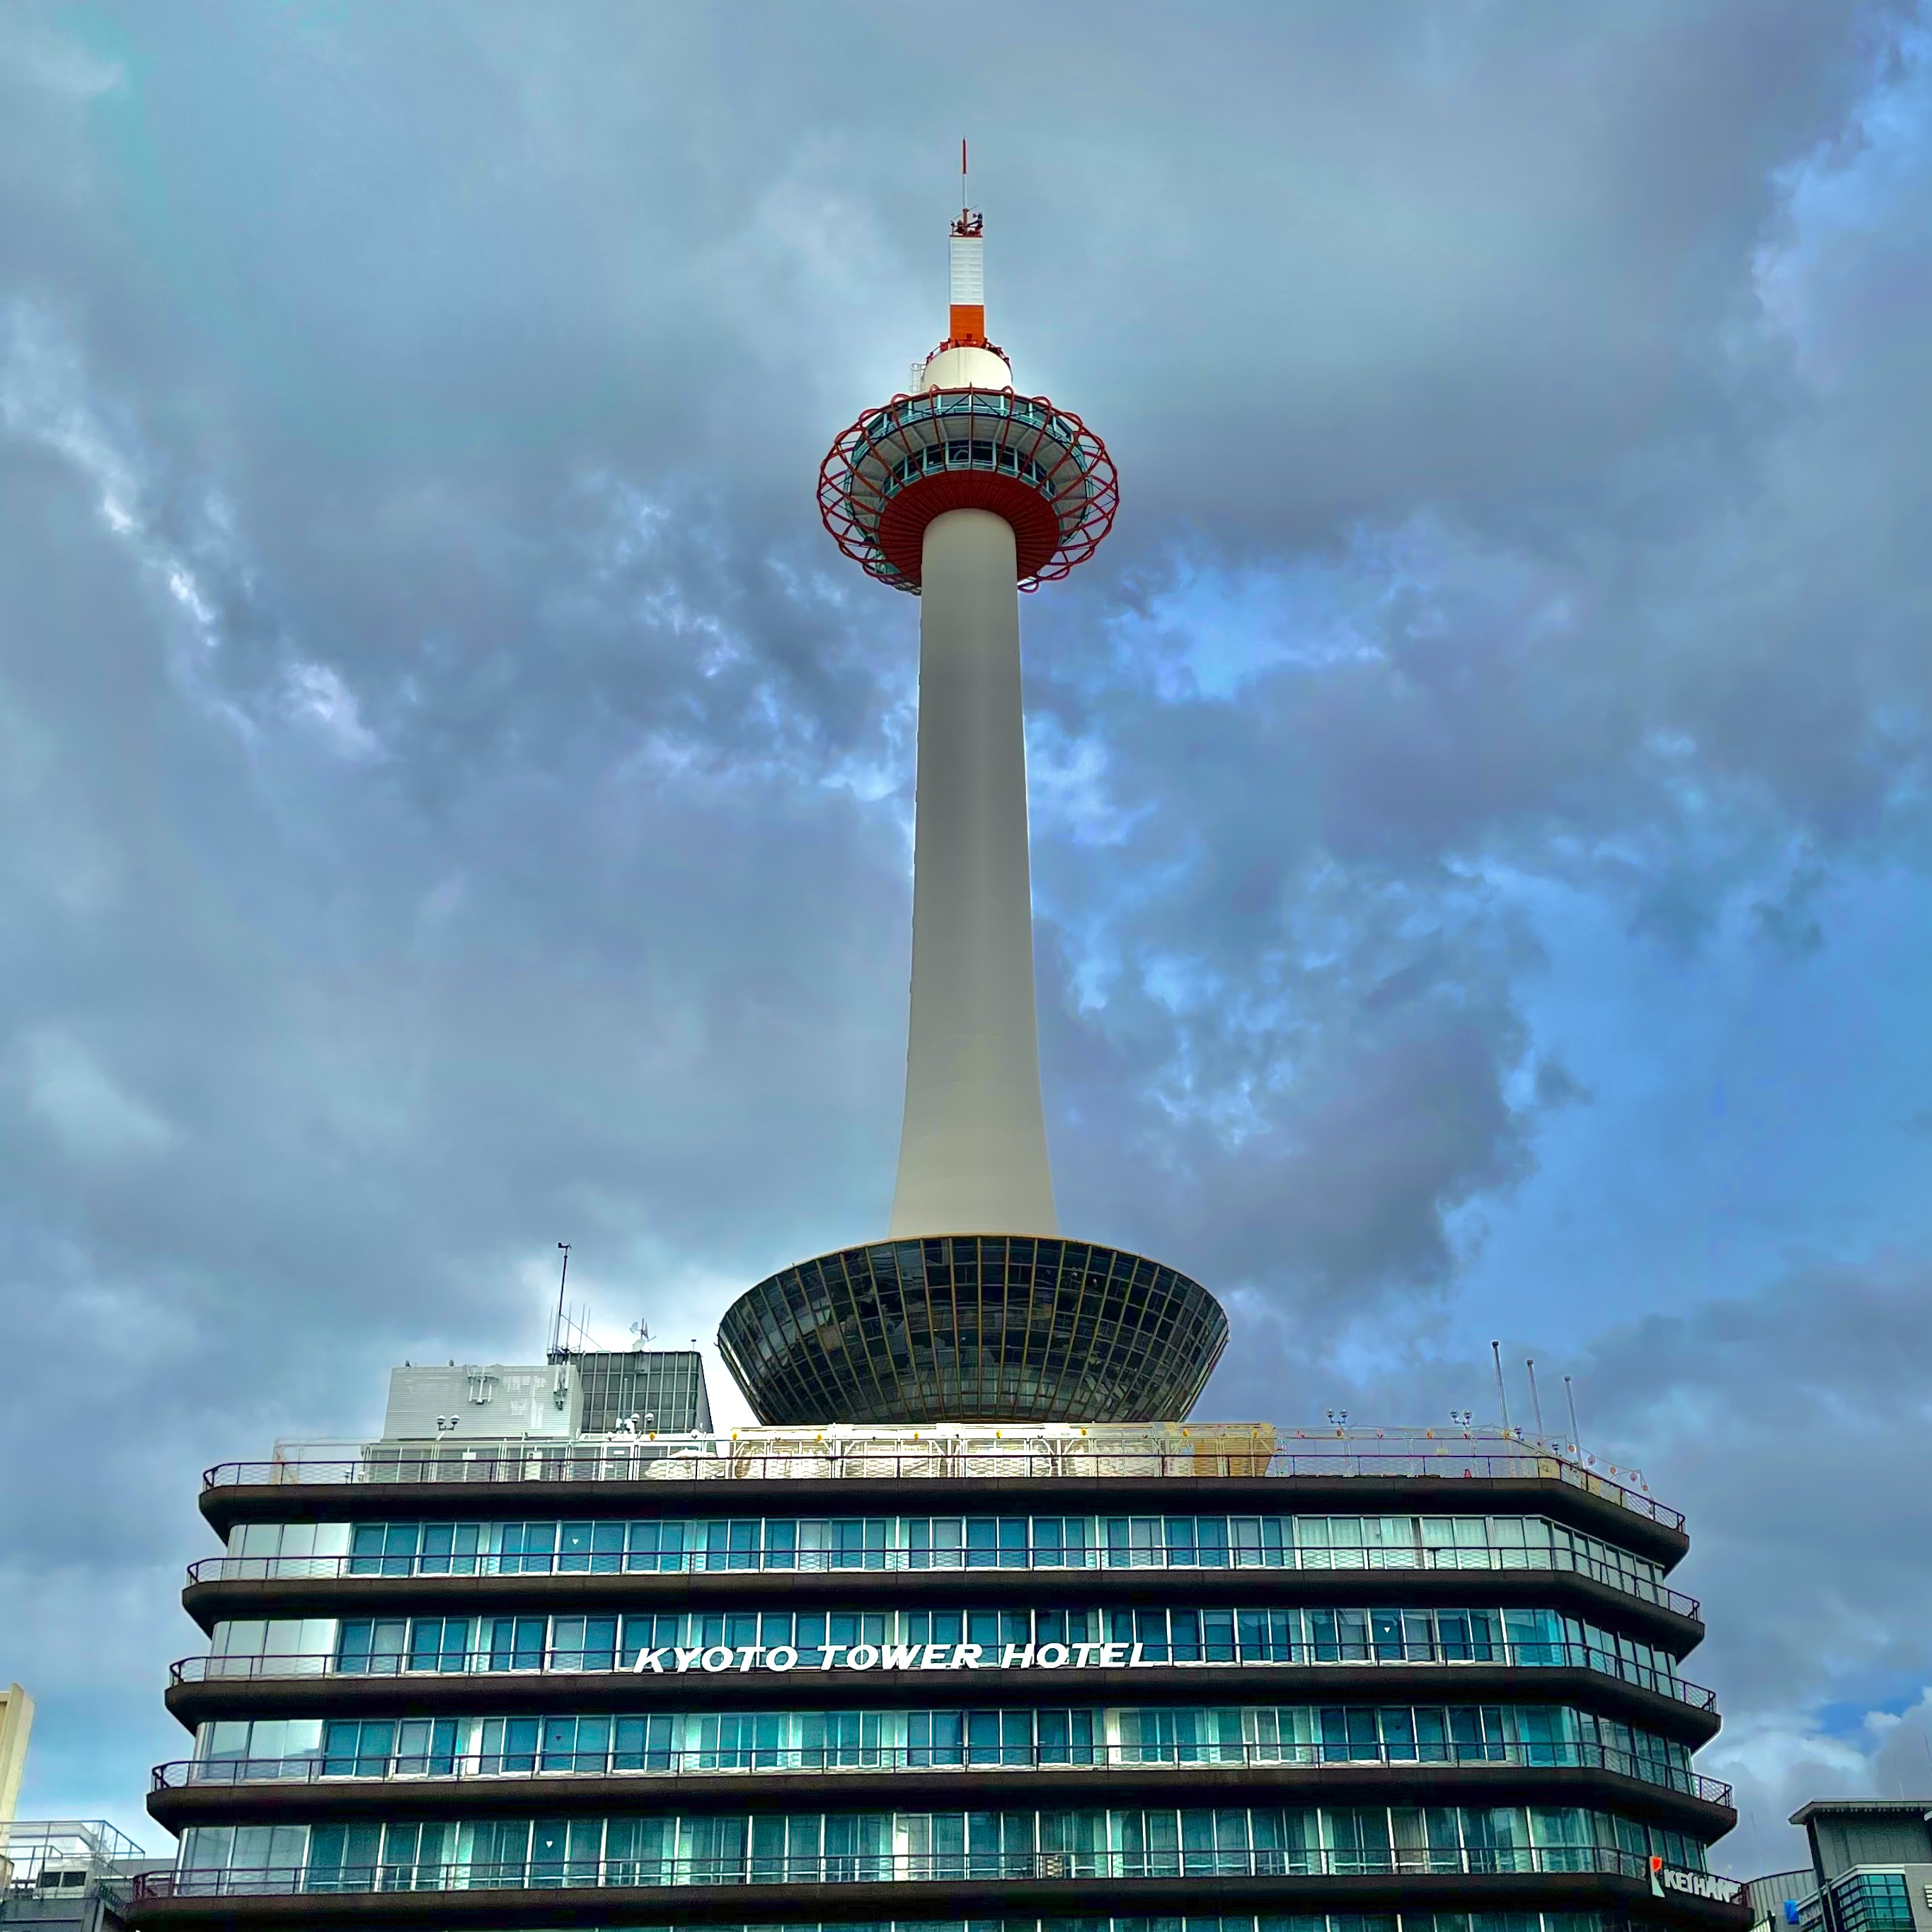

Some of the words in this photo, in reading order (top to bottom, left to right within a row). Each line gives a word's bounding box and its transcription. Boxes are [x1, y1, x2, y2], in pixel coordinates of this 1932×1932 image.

[633, 1646, 798, 1673] KYOTO
[817, 1644, 983, 1671] TOWER
[1001, 1643, 1155, 1669] HOTEL
